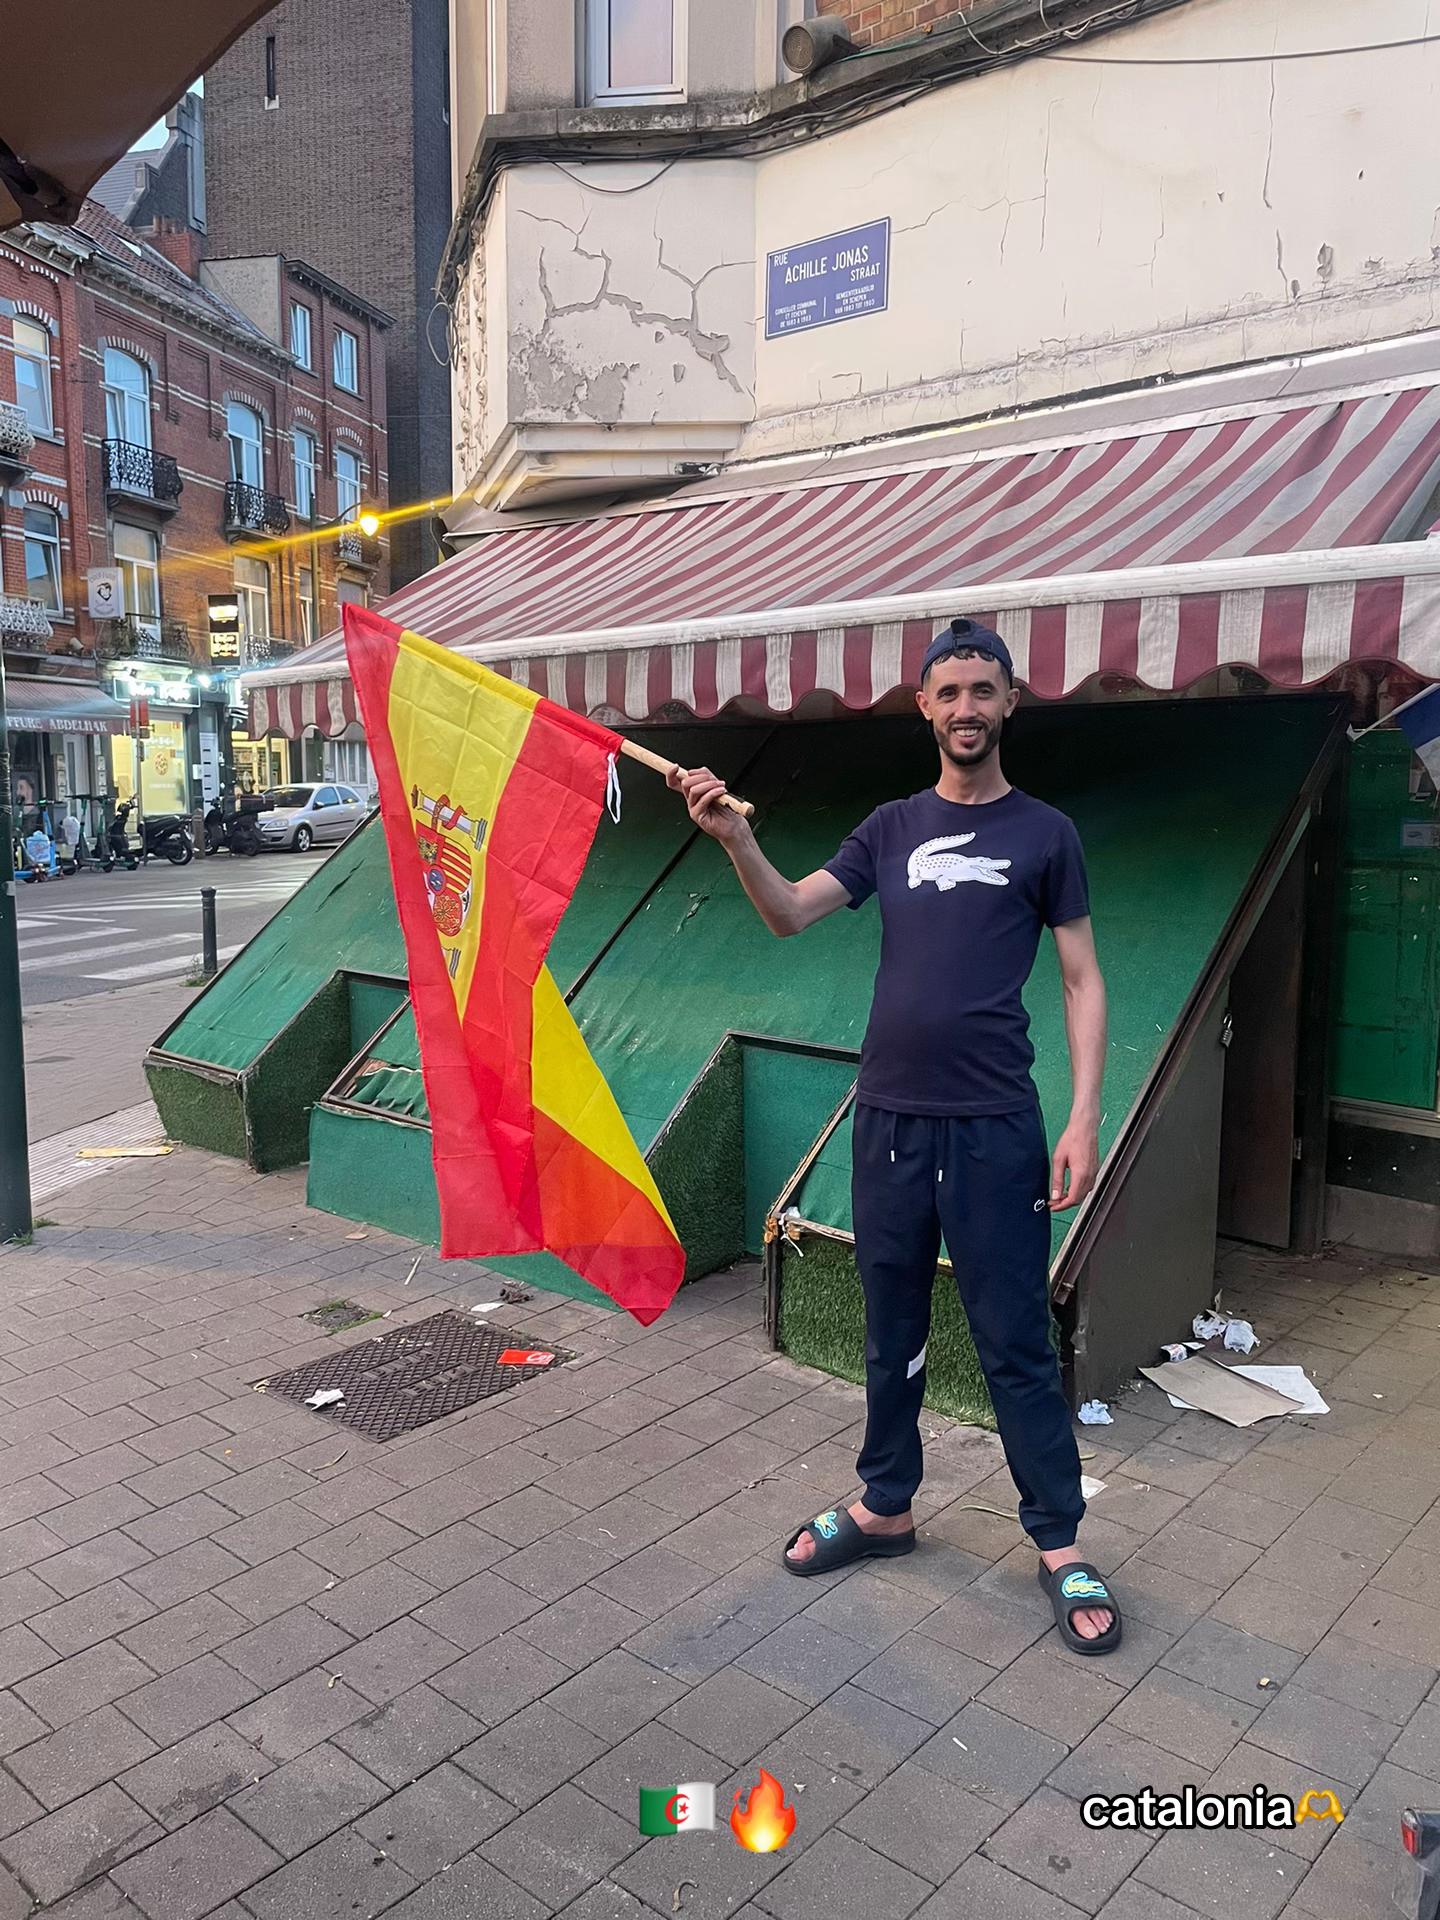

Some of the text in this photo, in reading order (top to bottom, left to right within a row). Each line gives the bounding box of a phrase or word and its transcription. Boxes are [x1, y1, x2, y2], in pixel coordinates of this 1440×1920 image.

[774, 252, 788, 266] RUE
[785, 245, 868, 284] ACHILLE JONAS
[850, 262, 880, 281] STRAAT
[6, 716, 42, 729] FFURE
